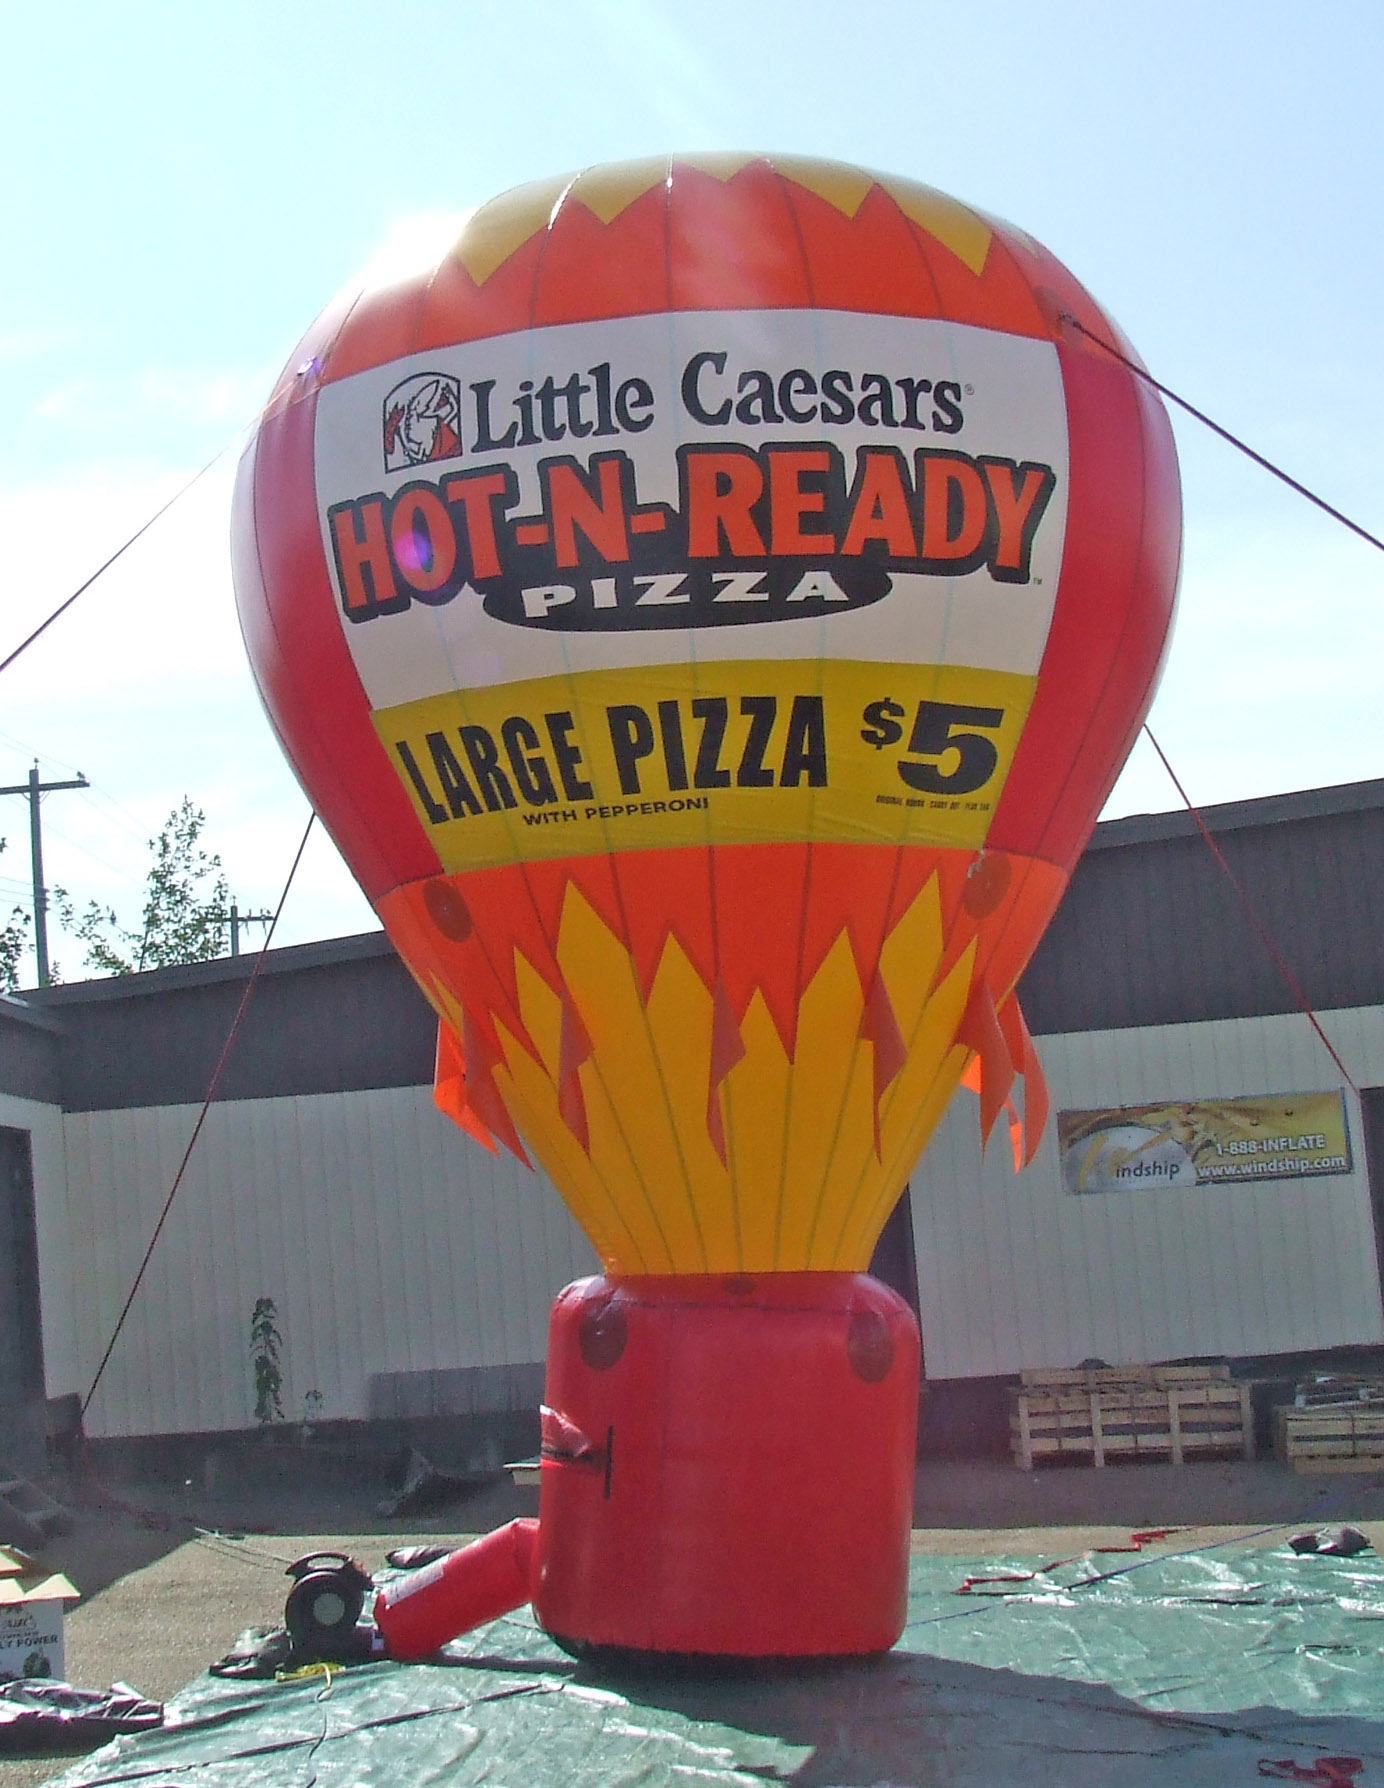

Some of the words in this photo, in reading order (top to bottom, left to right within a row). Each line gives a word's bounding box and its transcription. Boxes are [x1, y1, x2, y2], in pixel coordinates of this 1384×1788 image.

[469, 362, 655, 453] Little
[681, 352, 965, 433] Caesars
[521, 570, 852, 618] PIZZA
[395, 711, 595, 825] LARGE
[605, 695, 829, 796] PIZZA
[523, 809, 578, 826] WITH
[585, 797, 709, 820] PEPPERONI
[1215, 1134, 1326, 1157] 1-888-INFLATE
[1198, 1155, 1346, 1178] www.windship.com
[17, 1634, 58, 1648] POWER
